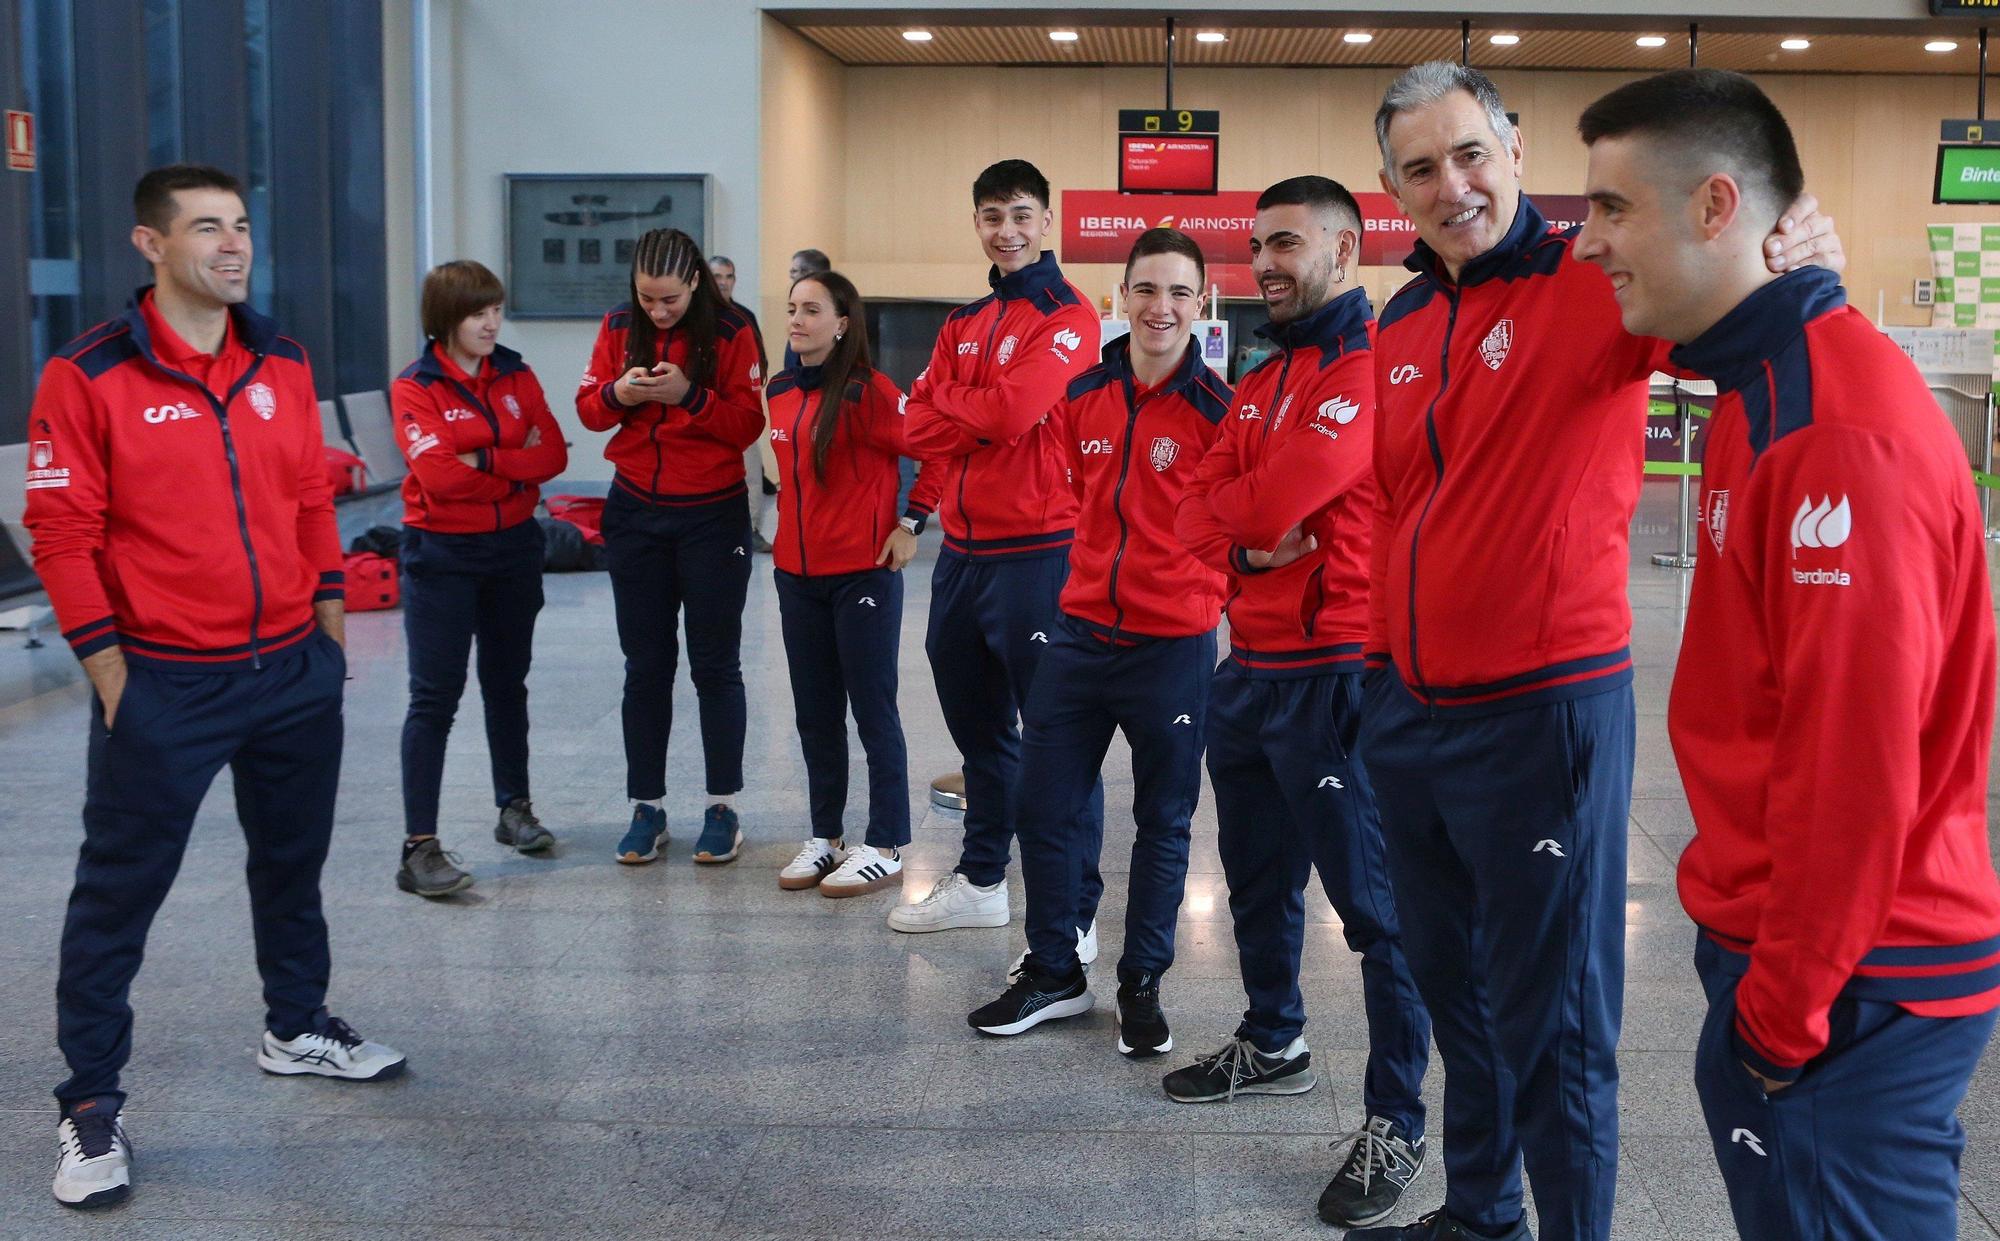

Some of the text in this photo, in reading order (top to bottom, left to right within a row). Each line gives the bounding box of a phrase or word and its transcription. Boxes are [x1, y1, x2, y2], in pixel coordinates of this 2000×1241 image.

[1178, 111, 1192, 131] 9
[1960, 166, 2000, 183] Binte
[1080, 217, 1147, 230] IBERIA
[1364, 218, 1417, 232] BERI
[1645, 426, 1673, 439] RIA
